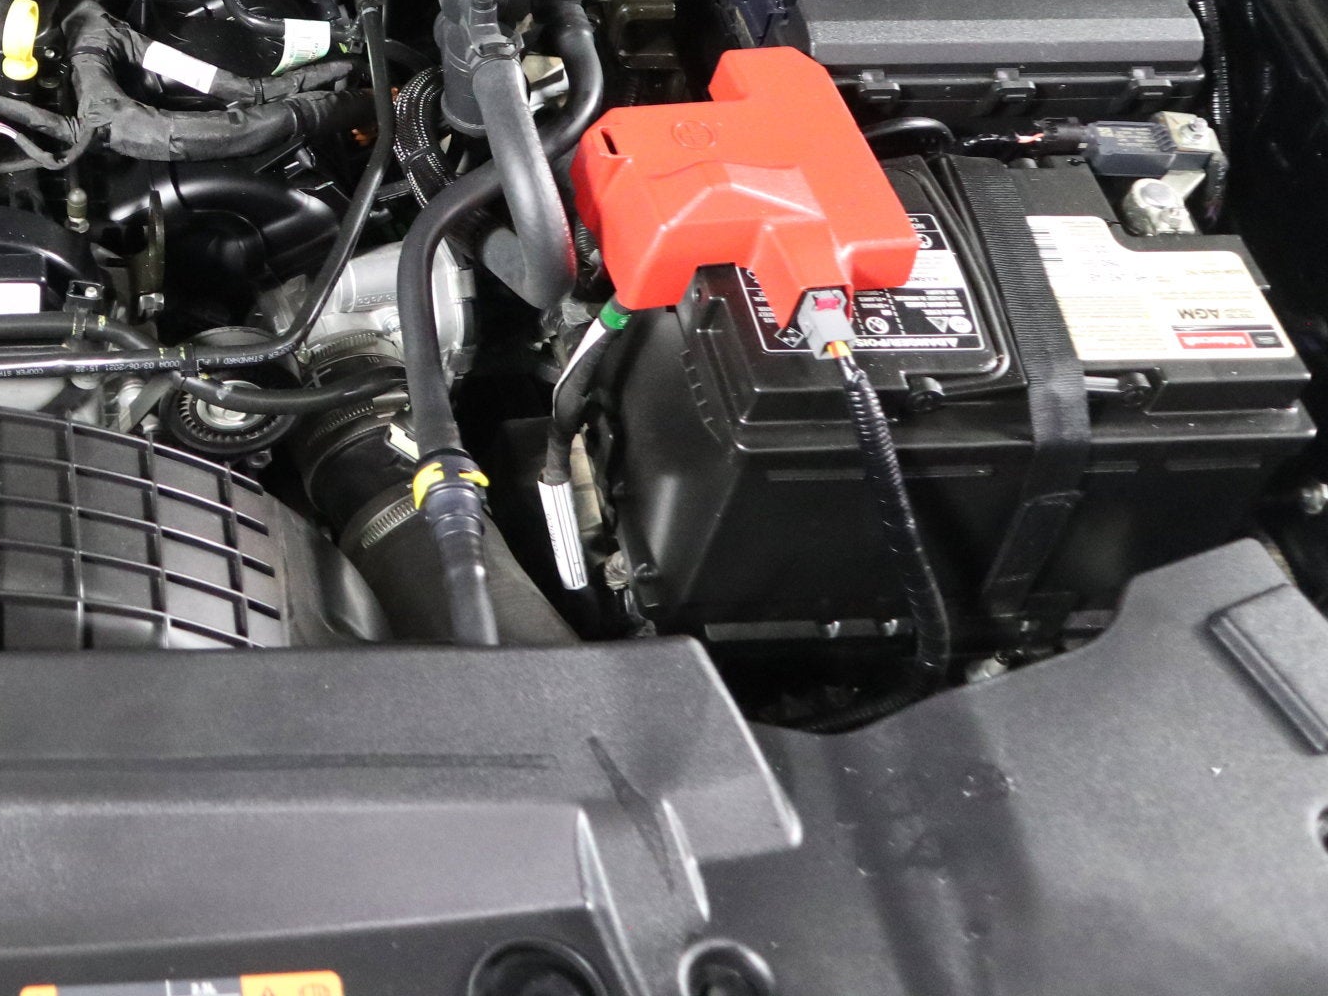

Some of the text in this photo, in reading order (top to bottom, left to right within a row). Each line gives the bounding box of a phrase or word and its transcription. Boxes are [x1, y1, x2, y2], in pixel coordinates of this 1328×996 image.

[1178, 307, 1219, 319] AGM
[223, 354, 264, 365] STANDARD
[16, 368, 45, 376] COOPER
